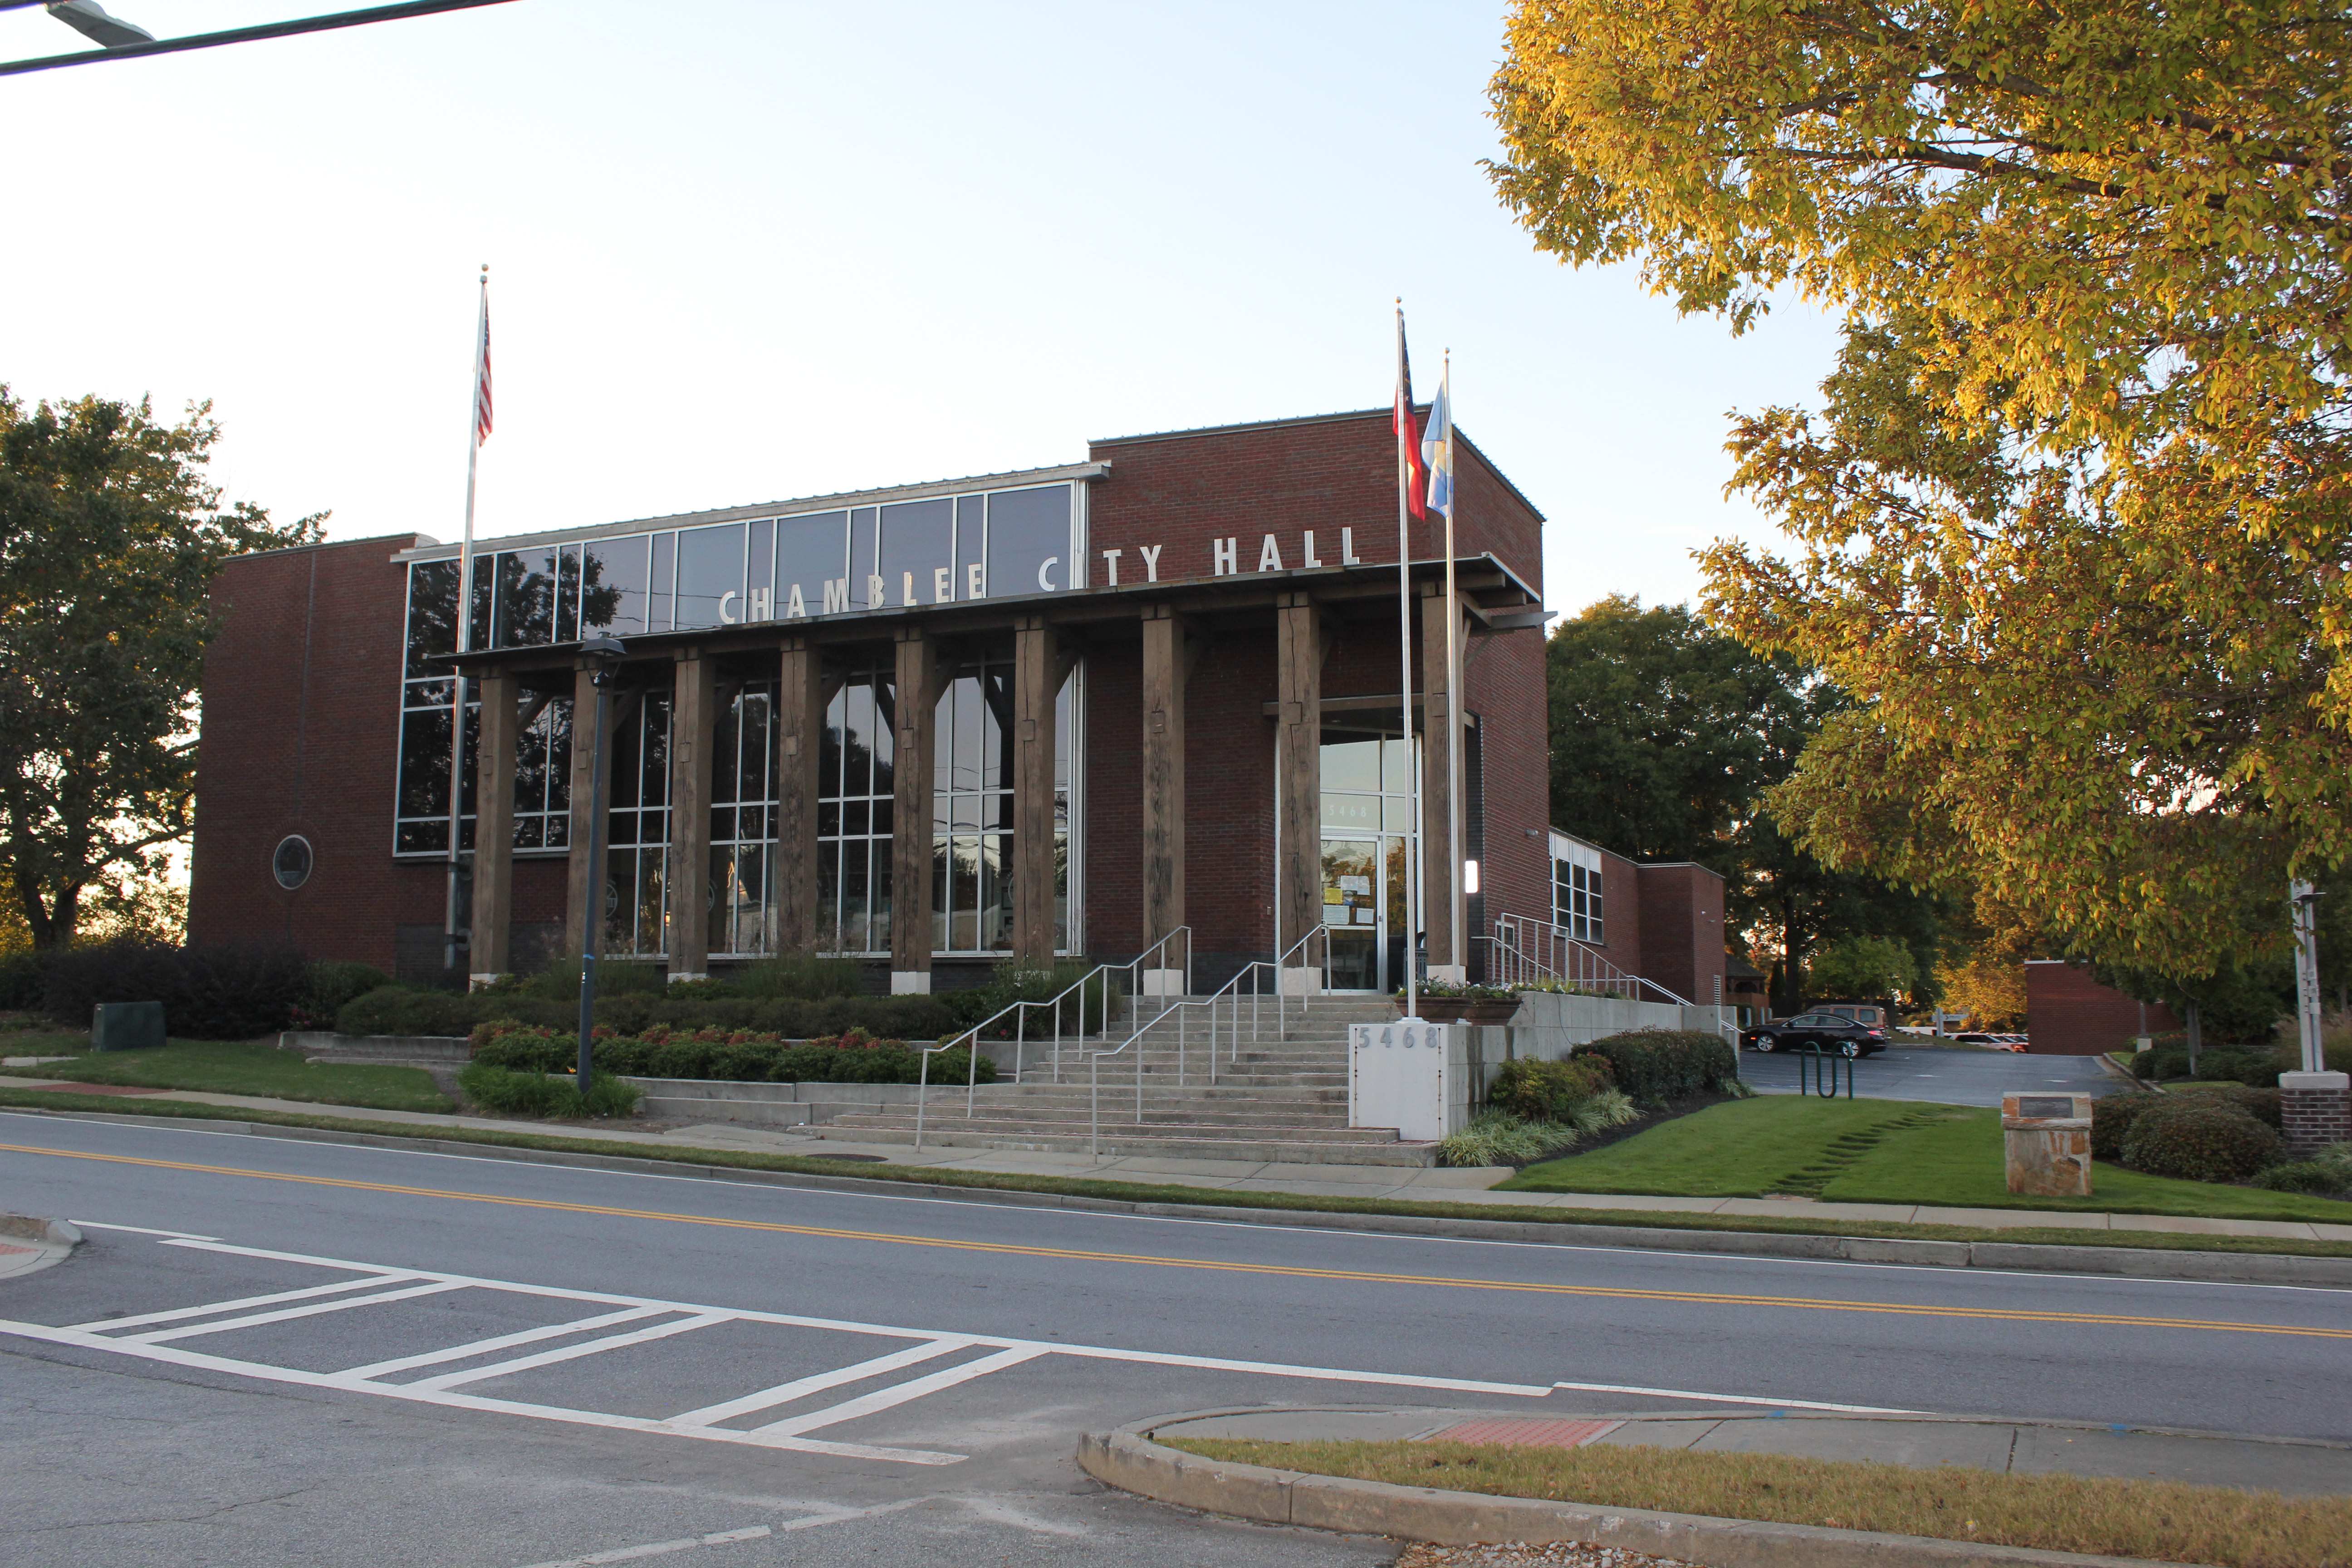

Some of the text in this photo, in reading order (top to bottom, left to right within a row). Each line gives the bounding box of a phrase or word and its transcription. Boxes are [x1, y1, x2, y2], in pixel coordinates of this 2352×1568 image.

[719, 527, 1360, 624] CHAMBLEE CITY HALL
[1329, 805, 1366, 817] 5468
[1359, 1027, 1437, 1048] 5468
